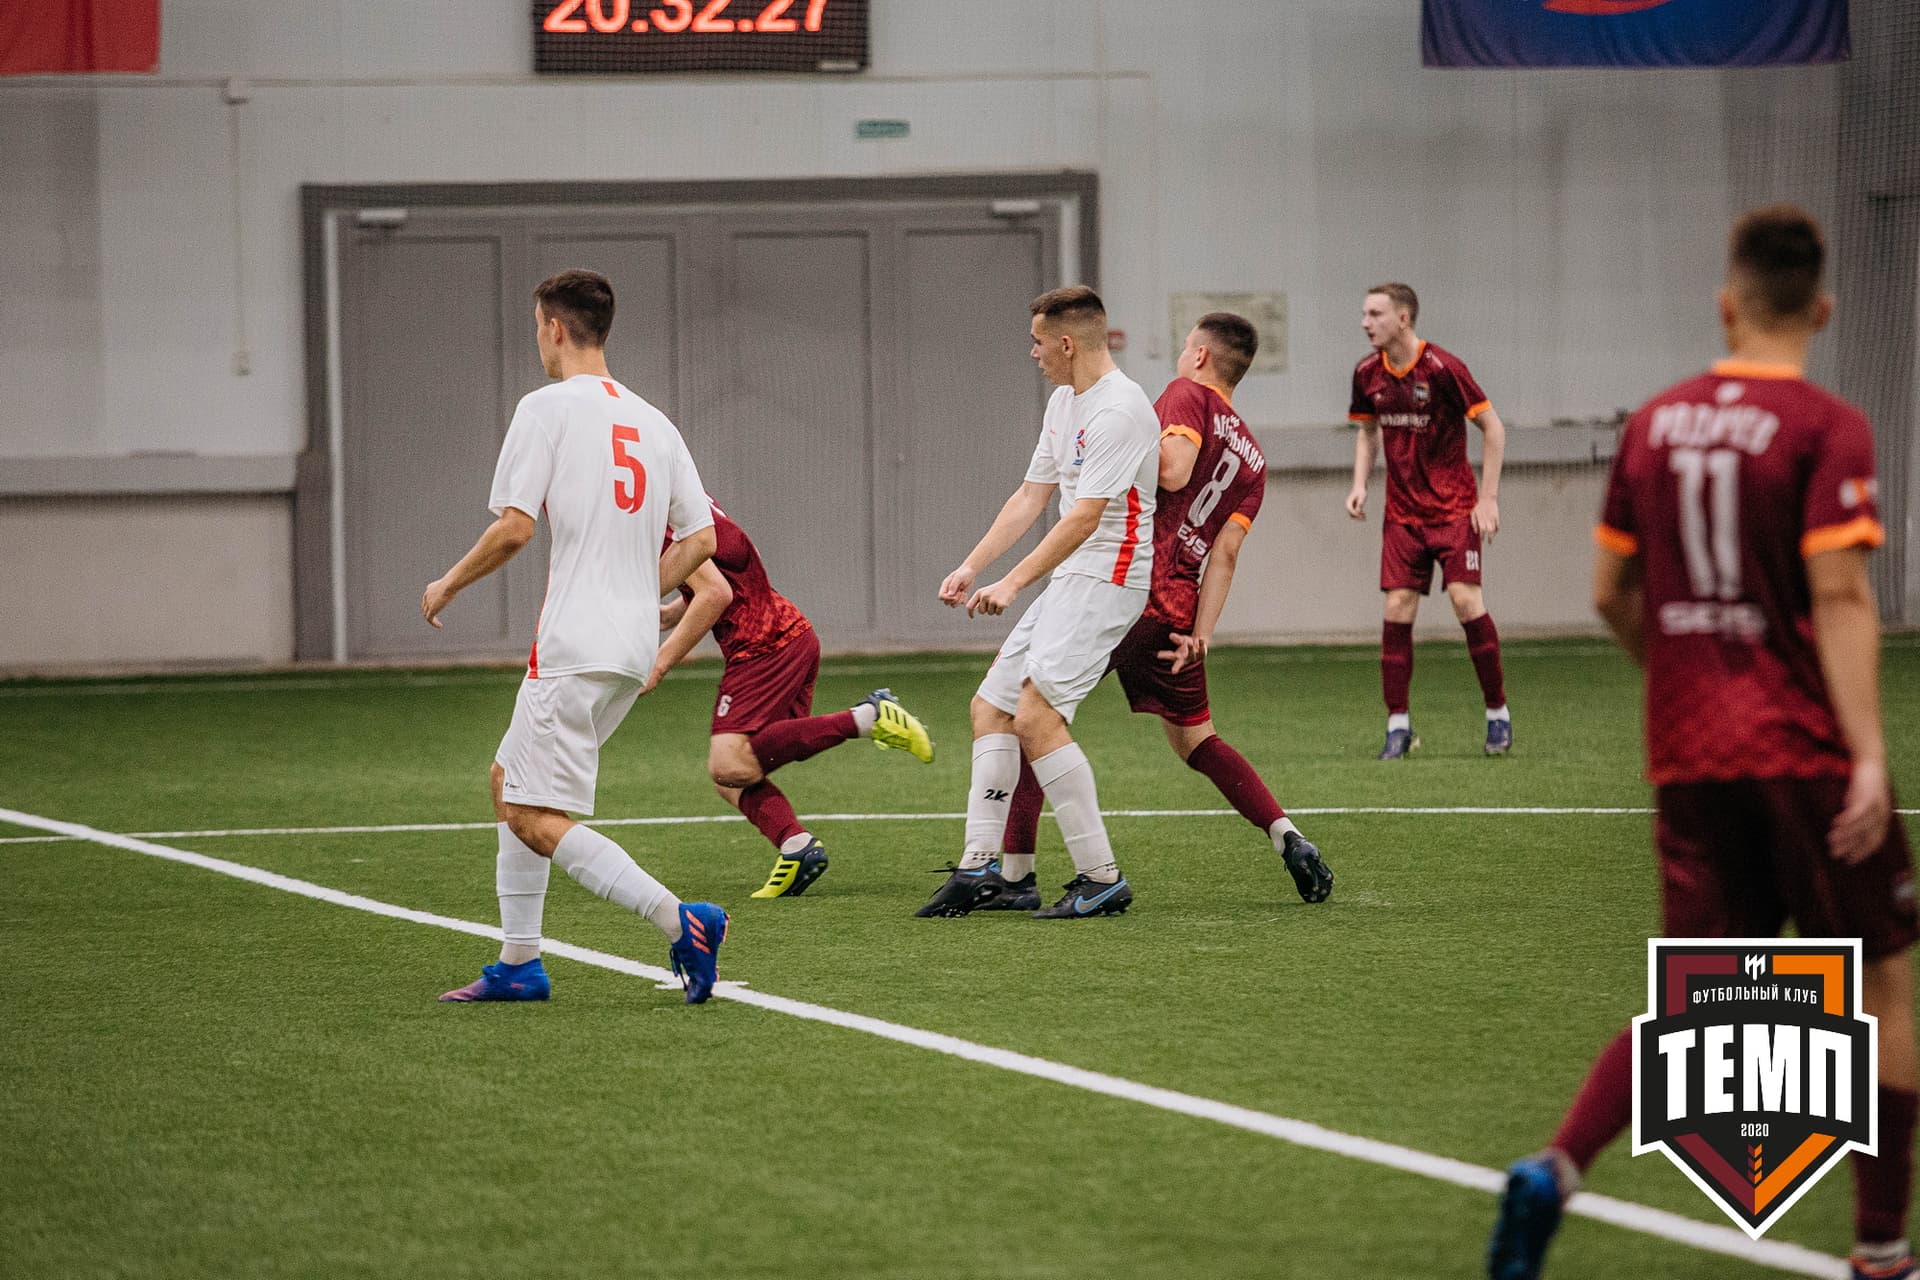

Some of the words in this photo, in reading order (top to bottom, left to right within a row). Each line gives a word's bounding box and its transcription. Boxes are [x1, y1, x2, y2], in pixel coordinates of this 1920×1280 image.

[611, 423, 647, 514] 5
[1187, 447, 1240, 527] 8
[1669, 449, 1741, 599] 11
[717, 694, 732, 717] 6
